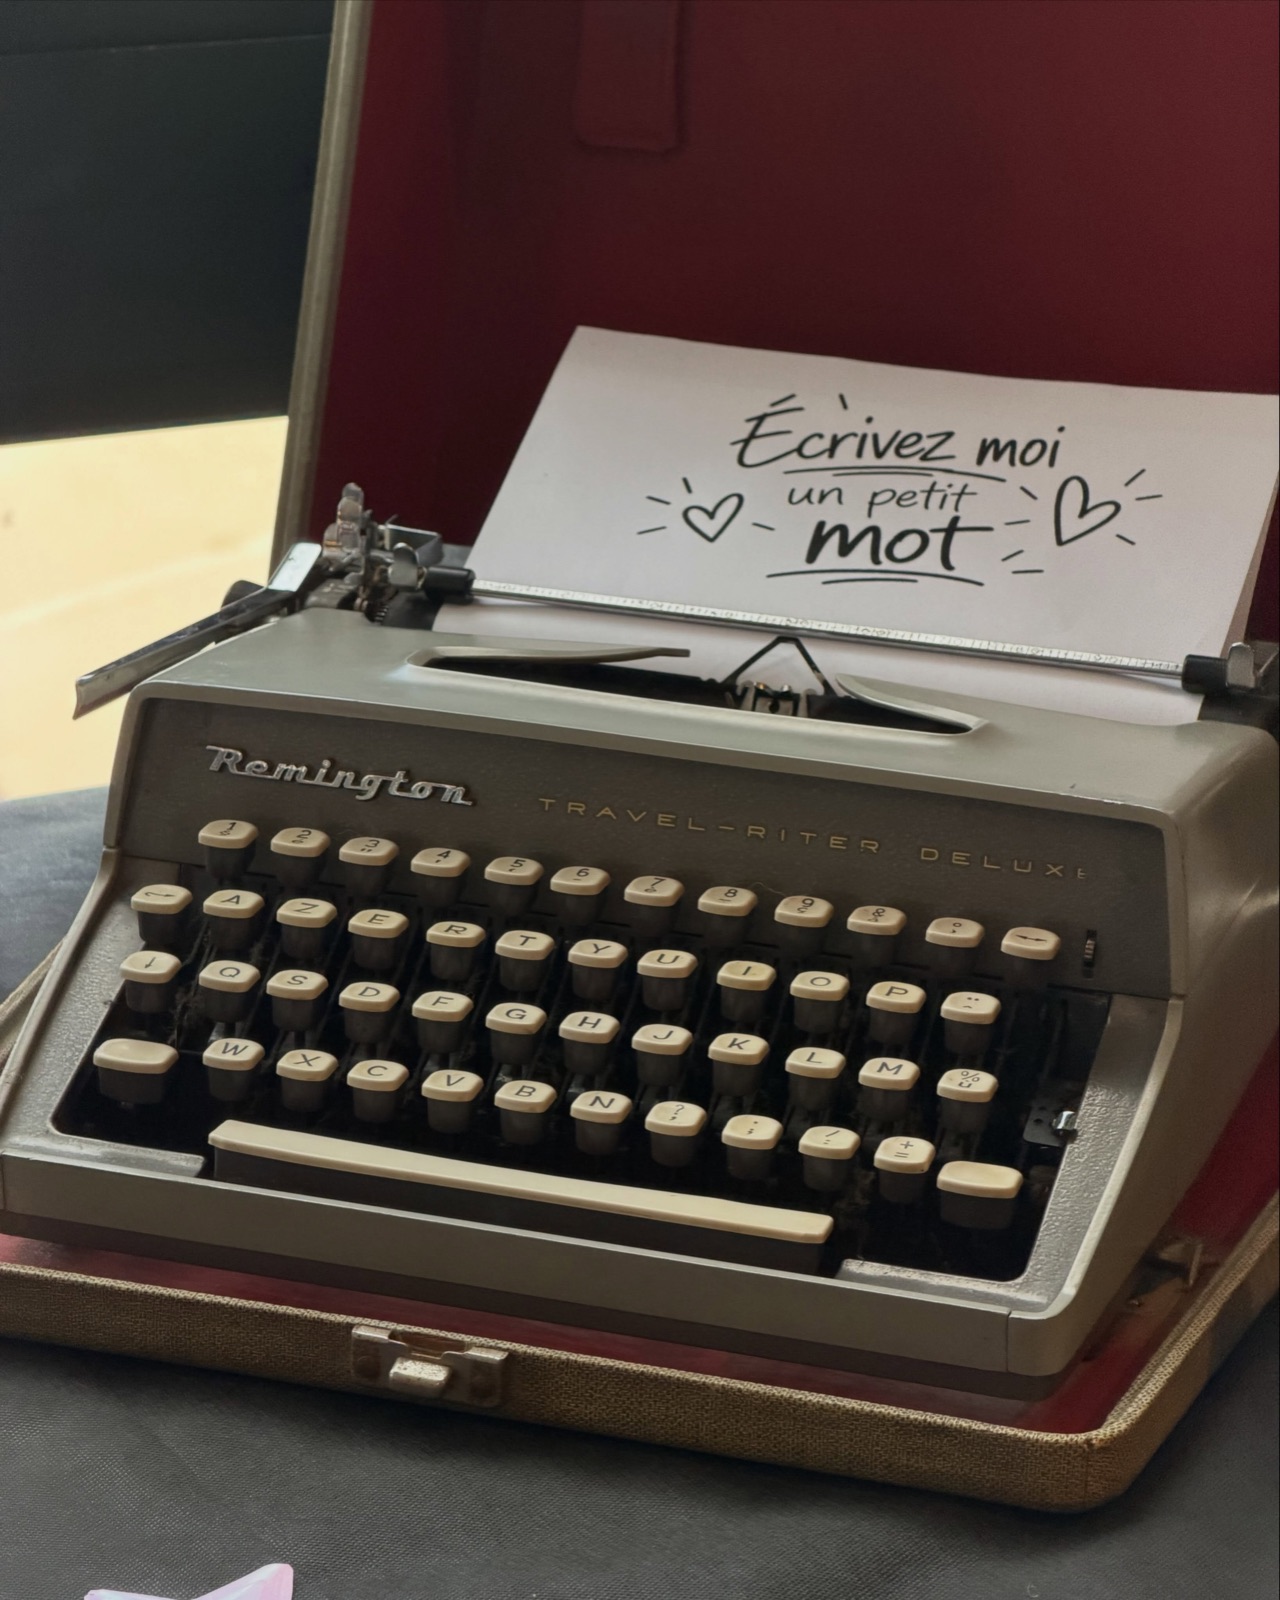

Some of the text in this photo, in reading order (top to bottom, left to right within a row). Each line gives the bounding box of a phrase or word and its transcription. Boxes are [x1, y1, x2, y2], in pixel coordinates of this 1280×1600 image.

[730, 394, 1065, 468] Écrivez moi
[788, 481, 977, 518] un petit
[805, 516, 994, 571] mot
[205, 745, 474, 806] Remington
[226, 821, 237, 831] 1
[296, 829, 312, 840] 2
[538, 798, 1087, 879] TRAVEL-RITER DELUXE
[365, 839, 380, 848] 3
[437, 850, 451, 859] 4
[510, 859, 526, 868] 5
[576, 868, 590, 877] 6
[651, 877, 667, 887] 7
[724, 888, 738, 898] 8
[220, 894, 241, 905] A
[801, 898, 815, 908] 9
[294, 902, 319, 914] Z
[367, 913, 390, 925] E
[444, 924, 467, 935] R
[519, 934, 537, 946] T
[593, 943, 611, 954] Y
[656, 953, 680, 964] U
[219, 967, 241, 978] Q
[742, 965, 752, 976] I
[287, 975, 308, 985] S
[810, 976, 831, 986] O
[358, 986, 381, 997] D
[885, 985, 909, 997] P
[431, 996, 454, 1006] F
[505, 1008, 527, 1020] G
[577, 1016, 602, 1029] H
[653, 1030, 674, 1040] J
[221, 1042, 249, 1056] W
[727, 1038, 750, 1050] K
[293, 1054, 321, 1067] X
[806, 1051, 823, 1064] L
[367, 1065, 388, 1076] C
[876, 1061, 904, 1075] M
[446, 1075, 466, 1086] V
[515, 1085, 536, 1097] B
[589, 1096, 615, 1109] N
